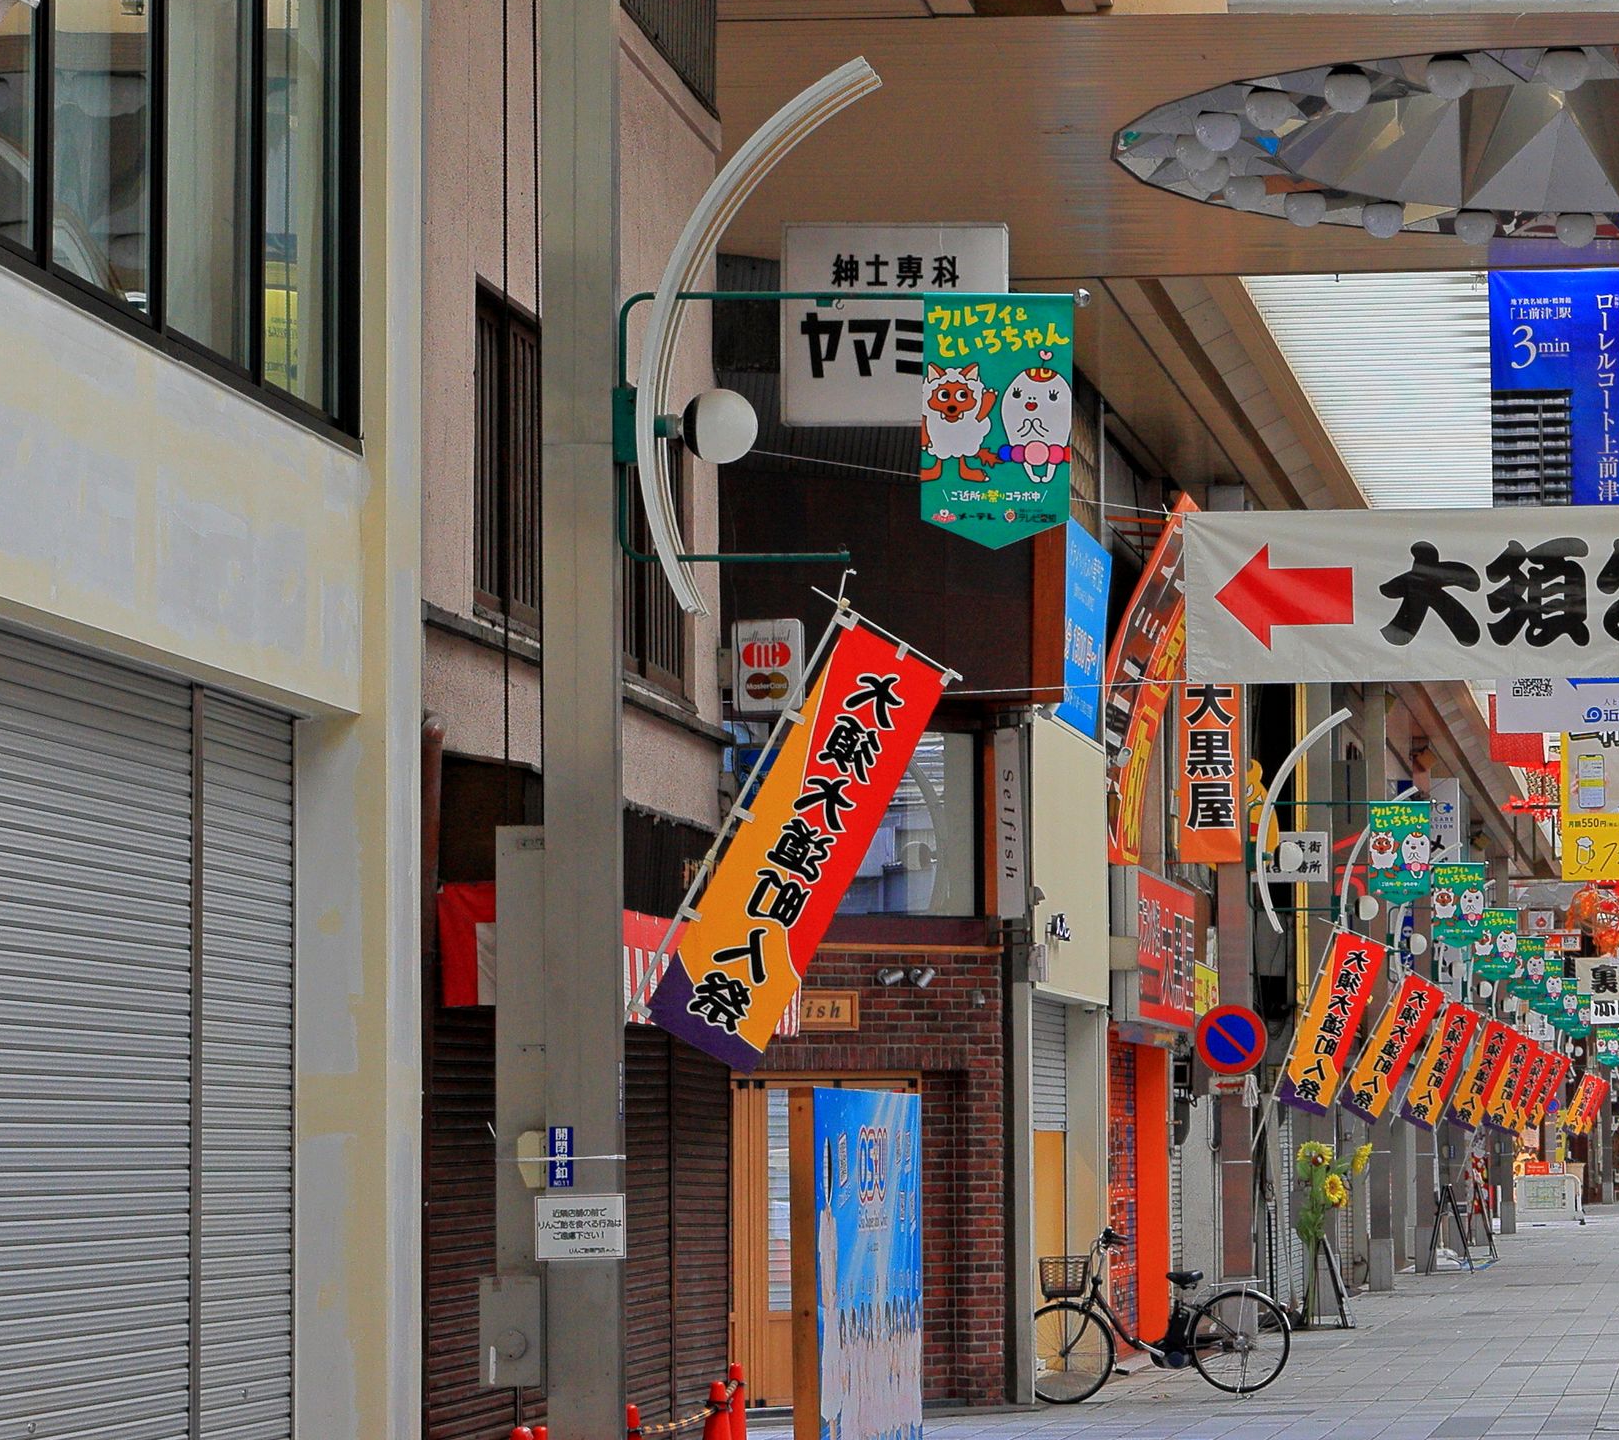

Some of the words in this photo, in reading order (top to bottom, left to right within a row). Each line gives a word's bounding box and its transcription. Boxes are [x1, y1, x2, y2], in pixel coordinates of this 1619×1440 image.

[831, 254, 961, 289] 紳士専科
[937, 323, 1070, 358] といろちゃん
[1595, 292, 1619, 502] ローレルコート上前津
[949, 488, 1042, 504] ご近所お祭りコラボ中
[745, 681, 789, 692] MasterCard
[1184, 684, 1237, 832] 大黒屋
[1002, 768, 1018, 880] Selfish
